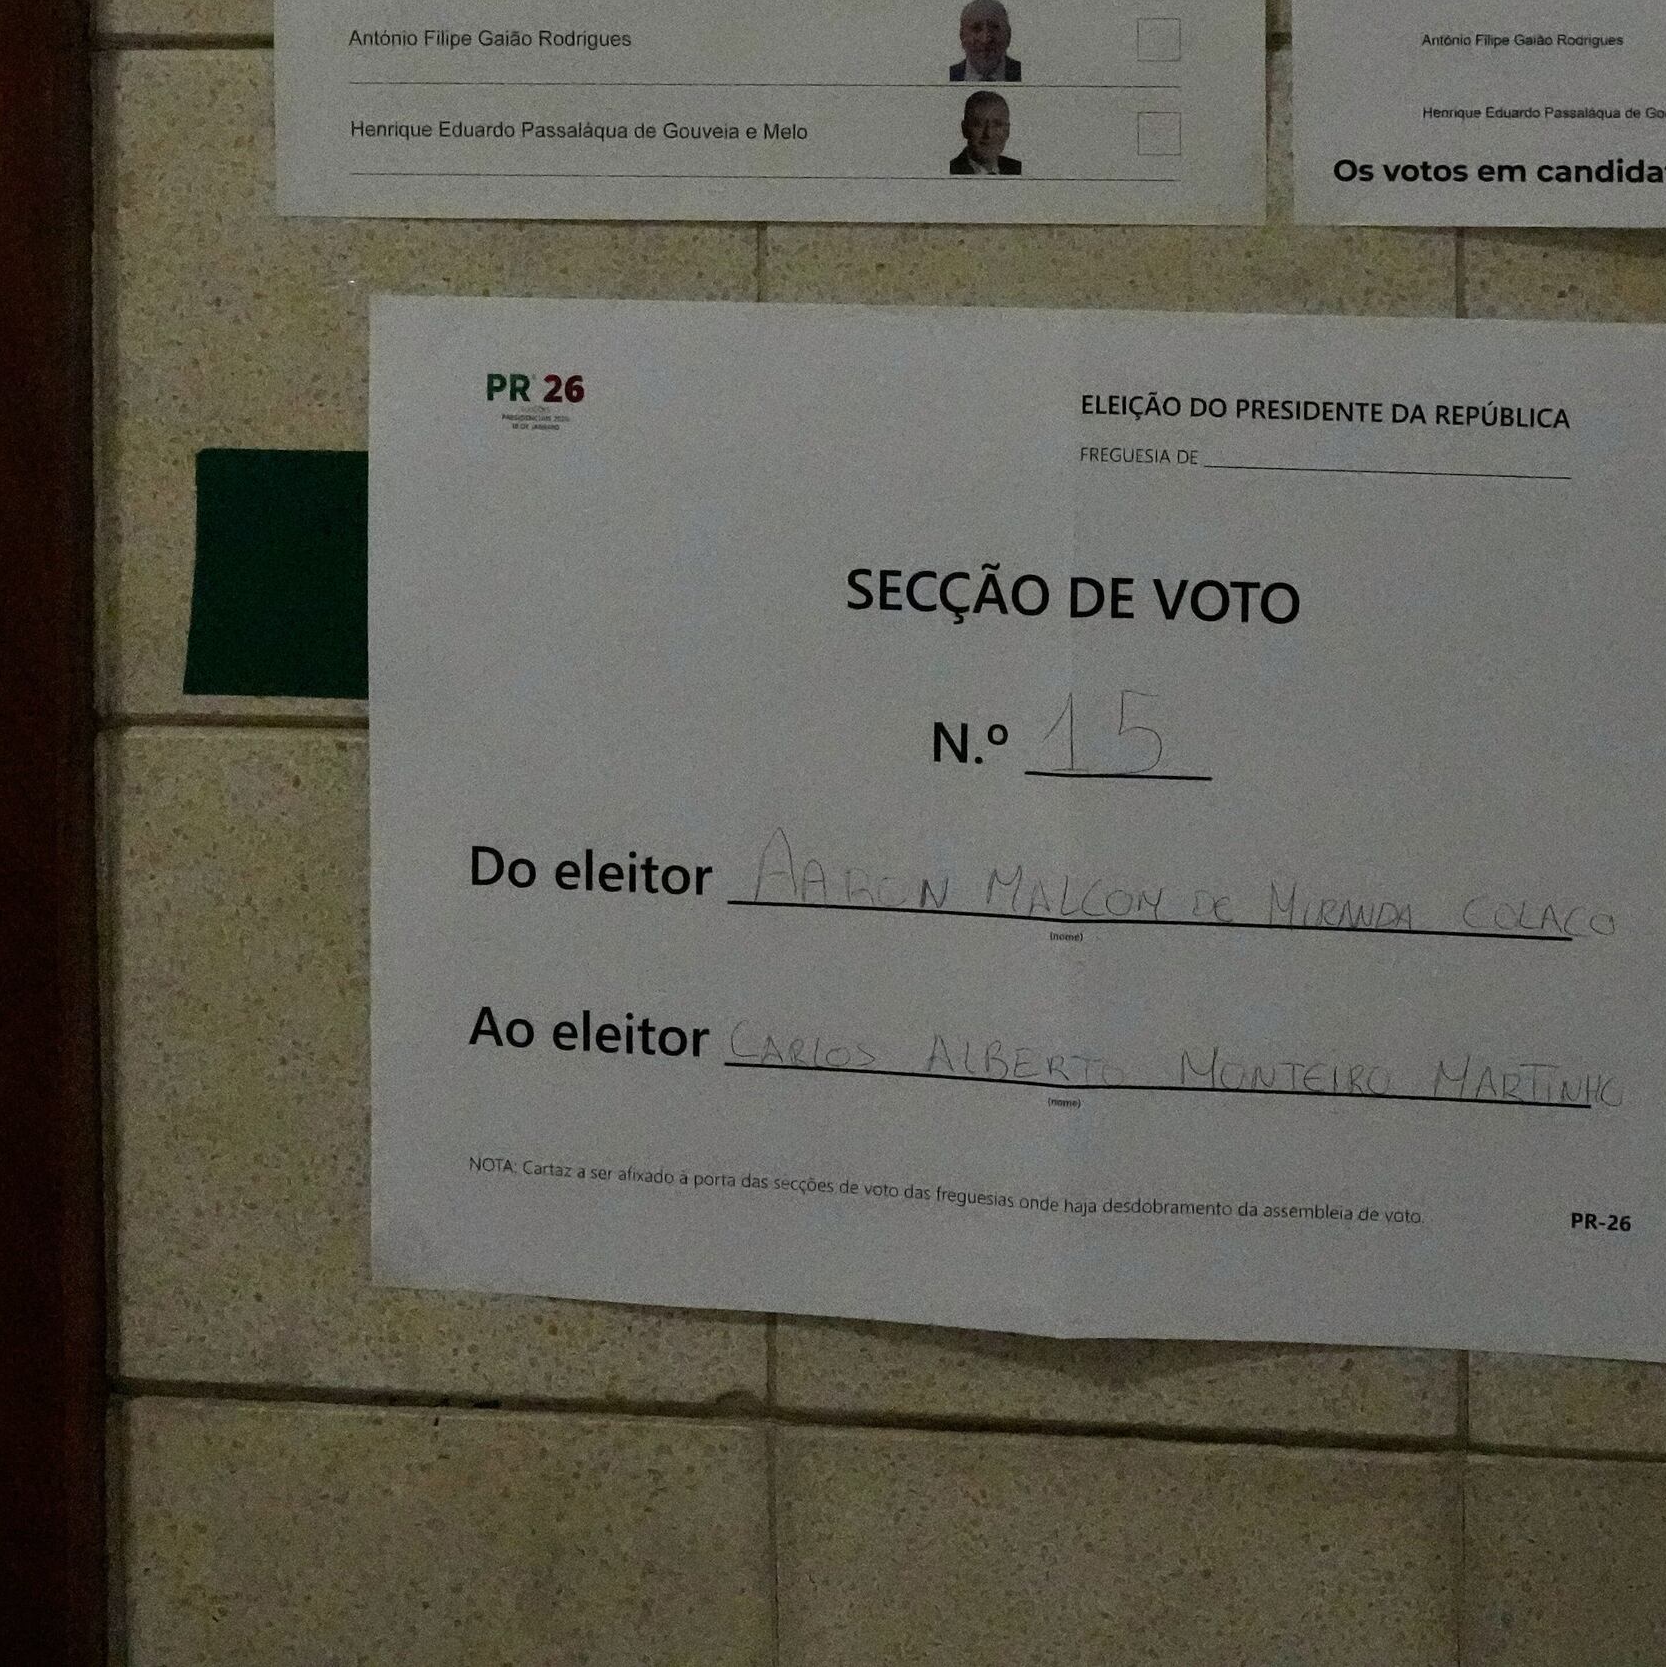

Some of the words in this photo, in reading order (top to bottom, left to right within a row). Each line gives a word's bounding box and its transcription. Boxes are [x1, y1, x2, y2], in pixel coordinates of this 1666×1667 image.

[350, 119, 434, 142] Henrique
[437, 119, 516, 140] Eduardo
[520, 119, 629, 143] Passaláqua
[633, 122, 657, 141] de
[662, 120, 741, 141] Gouveia
[744, 126, 758, 142] e
[762, 122, 809, 142] Melo
[1332, 157, 1375, 183] Os
[1382, 160, 1469, 184] votos
[1476, 163, 1527, 184] em
[1081, 389, 1182, 422] ELEIÇÃO
[1189, 395, 1228, 420] DO
[1235, 396, 1383, 425] PRESIDENTE
[1391, 401, 1427, 426] DA
[1435, 400, 1571, 431] REPÚBLICA
[1081, 447, 1172, 464] FREGUESIA
[1177, 450, 1199, 465] DE
[846, 561, 1050, 626] SECÇÃO
[1069, 575, 1135, 621] DE
[1152, 577, 1301, 626] VOTO
[1041, 689, 1163, 776] 15
[470, 843, 537, 890] Do
[554, 847, 714, 897] eleitor
[468, 1004, 535, 1050] Ao
[552, 1008, 711, 1059] eleitor
[730, 1019, 876, 1069] CARLOS
[926, 1034, 1126, 1087] ALBERTO
[1180, 1046, 1392, 1096] MONTEIRO
[523, 1160, 573, 1179] Cartaz
[577, 1168, 586, 1179] a
[591, 1169, 612, 1181] ser
[618, 1166, 675, 1185] afixado
[694, 1171, 736, 1189] porta
[741, 1173, 769, 1191] das
[839, 1179, 859, 1196] de
[864, 1184, 900, 1199] voto
[905, 1183, 932, 1200] das
[936, 1186, 1015, 1209] freguesias
[1019, 1193, 1059, 1213] onde
[1064, 1197, 1098, 1218] haja
[1103, 1196, 1233, 1217] desdobramento
[1238, 1201, 1259, 1217] da
[1263, 1202, 1353, 1222] assembleia
[1359, 1206, 1380, 1223] de
[1385, 1209, 1426, 1225] voto.
[1570, 1210, 1632, 1234] PR-26
